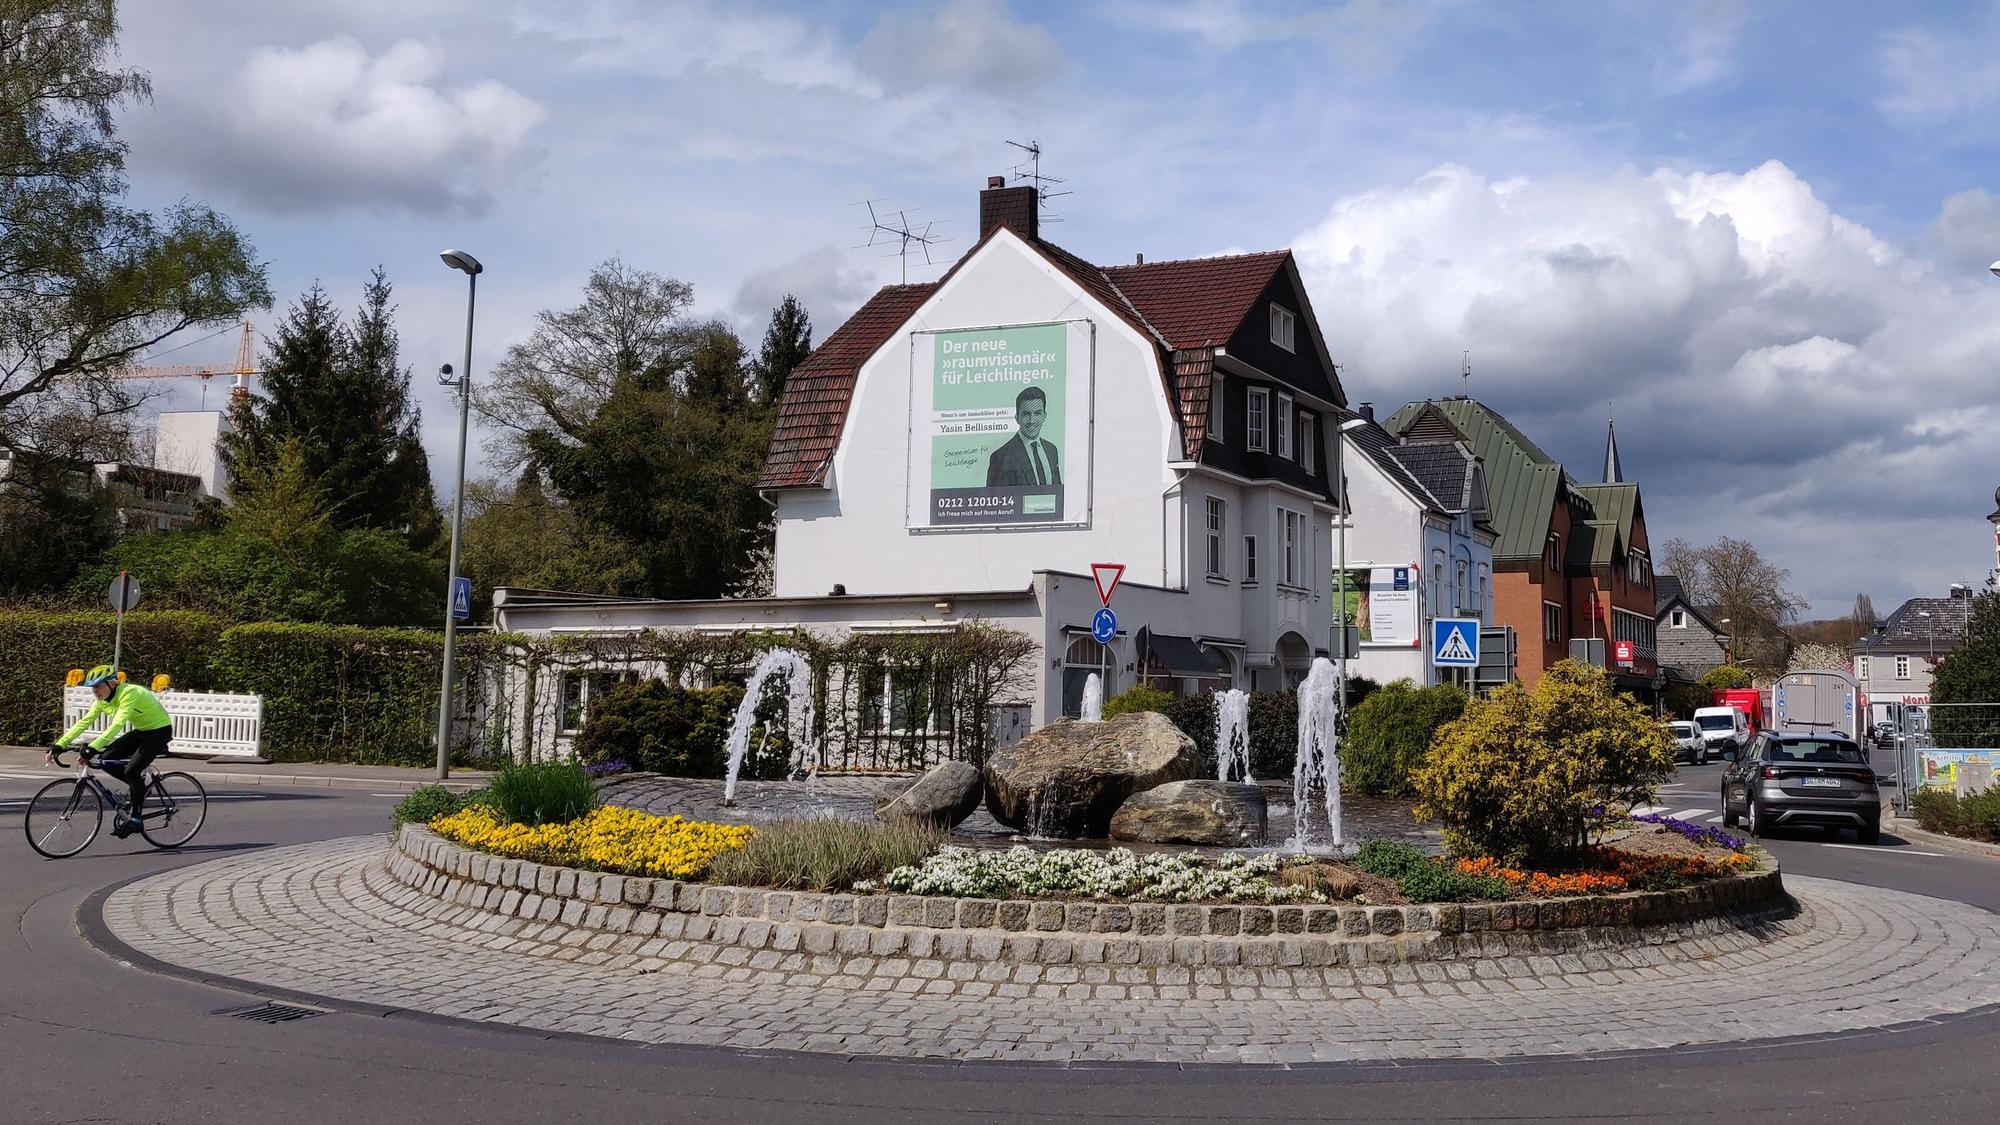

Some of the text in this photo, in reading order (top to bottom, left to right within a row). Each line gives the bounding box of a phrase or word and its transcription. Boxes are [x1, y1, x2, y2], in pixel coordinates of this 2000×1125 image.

[943, 339, 1007, 354] Der neue
[942, 350, 1056, 369] »raumvisionär«
[942, 367, 1054, 385] für Leichlingen.
[940, 422, 1009, 433] Yasin Bellissimo
[938, 498, 963, 508] 0212
[967, 496, 1015, 507] 12010-14
